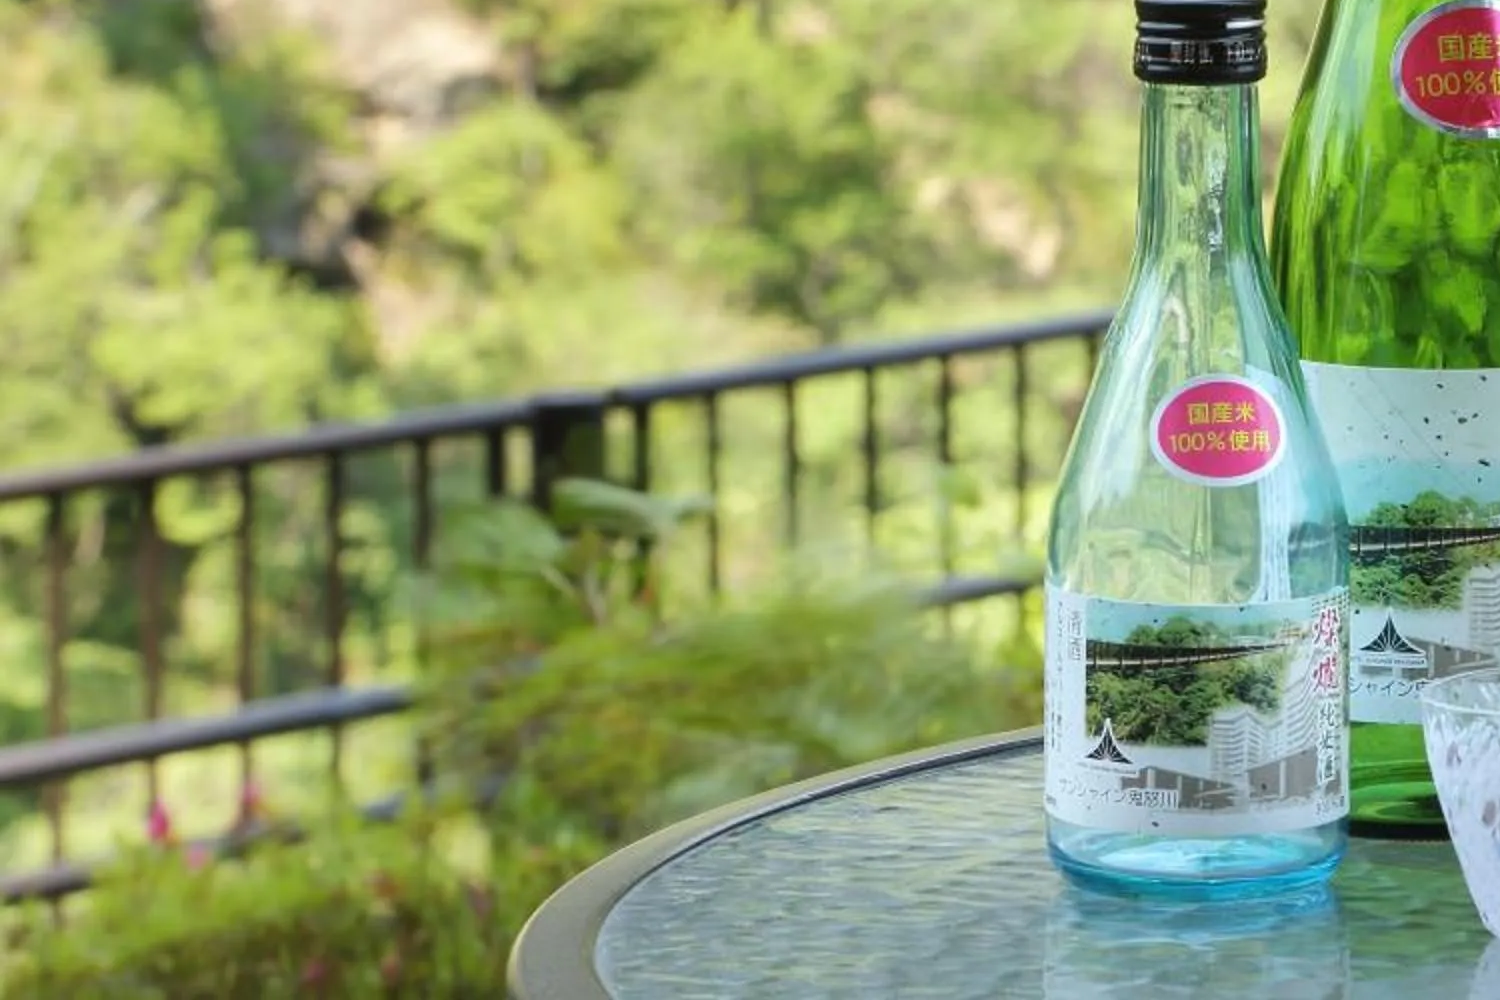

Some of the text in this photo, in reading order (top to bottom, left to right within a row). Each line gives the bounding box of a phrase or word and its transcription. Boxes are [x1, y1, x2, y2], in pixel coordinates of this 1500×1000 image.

[1188, 400, 1255, 425] 国産米
[1169, 429, 1271, 453] 100%使用
